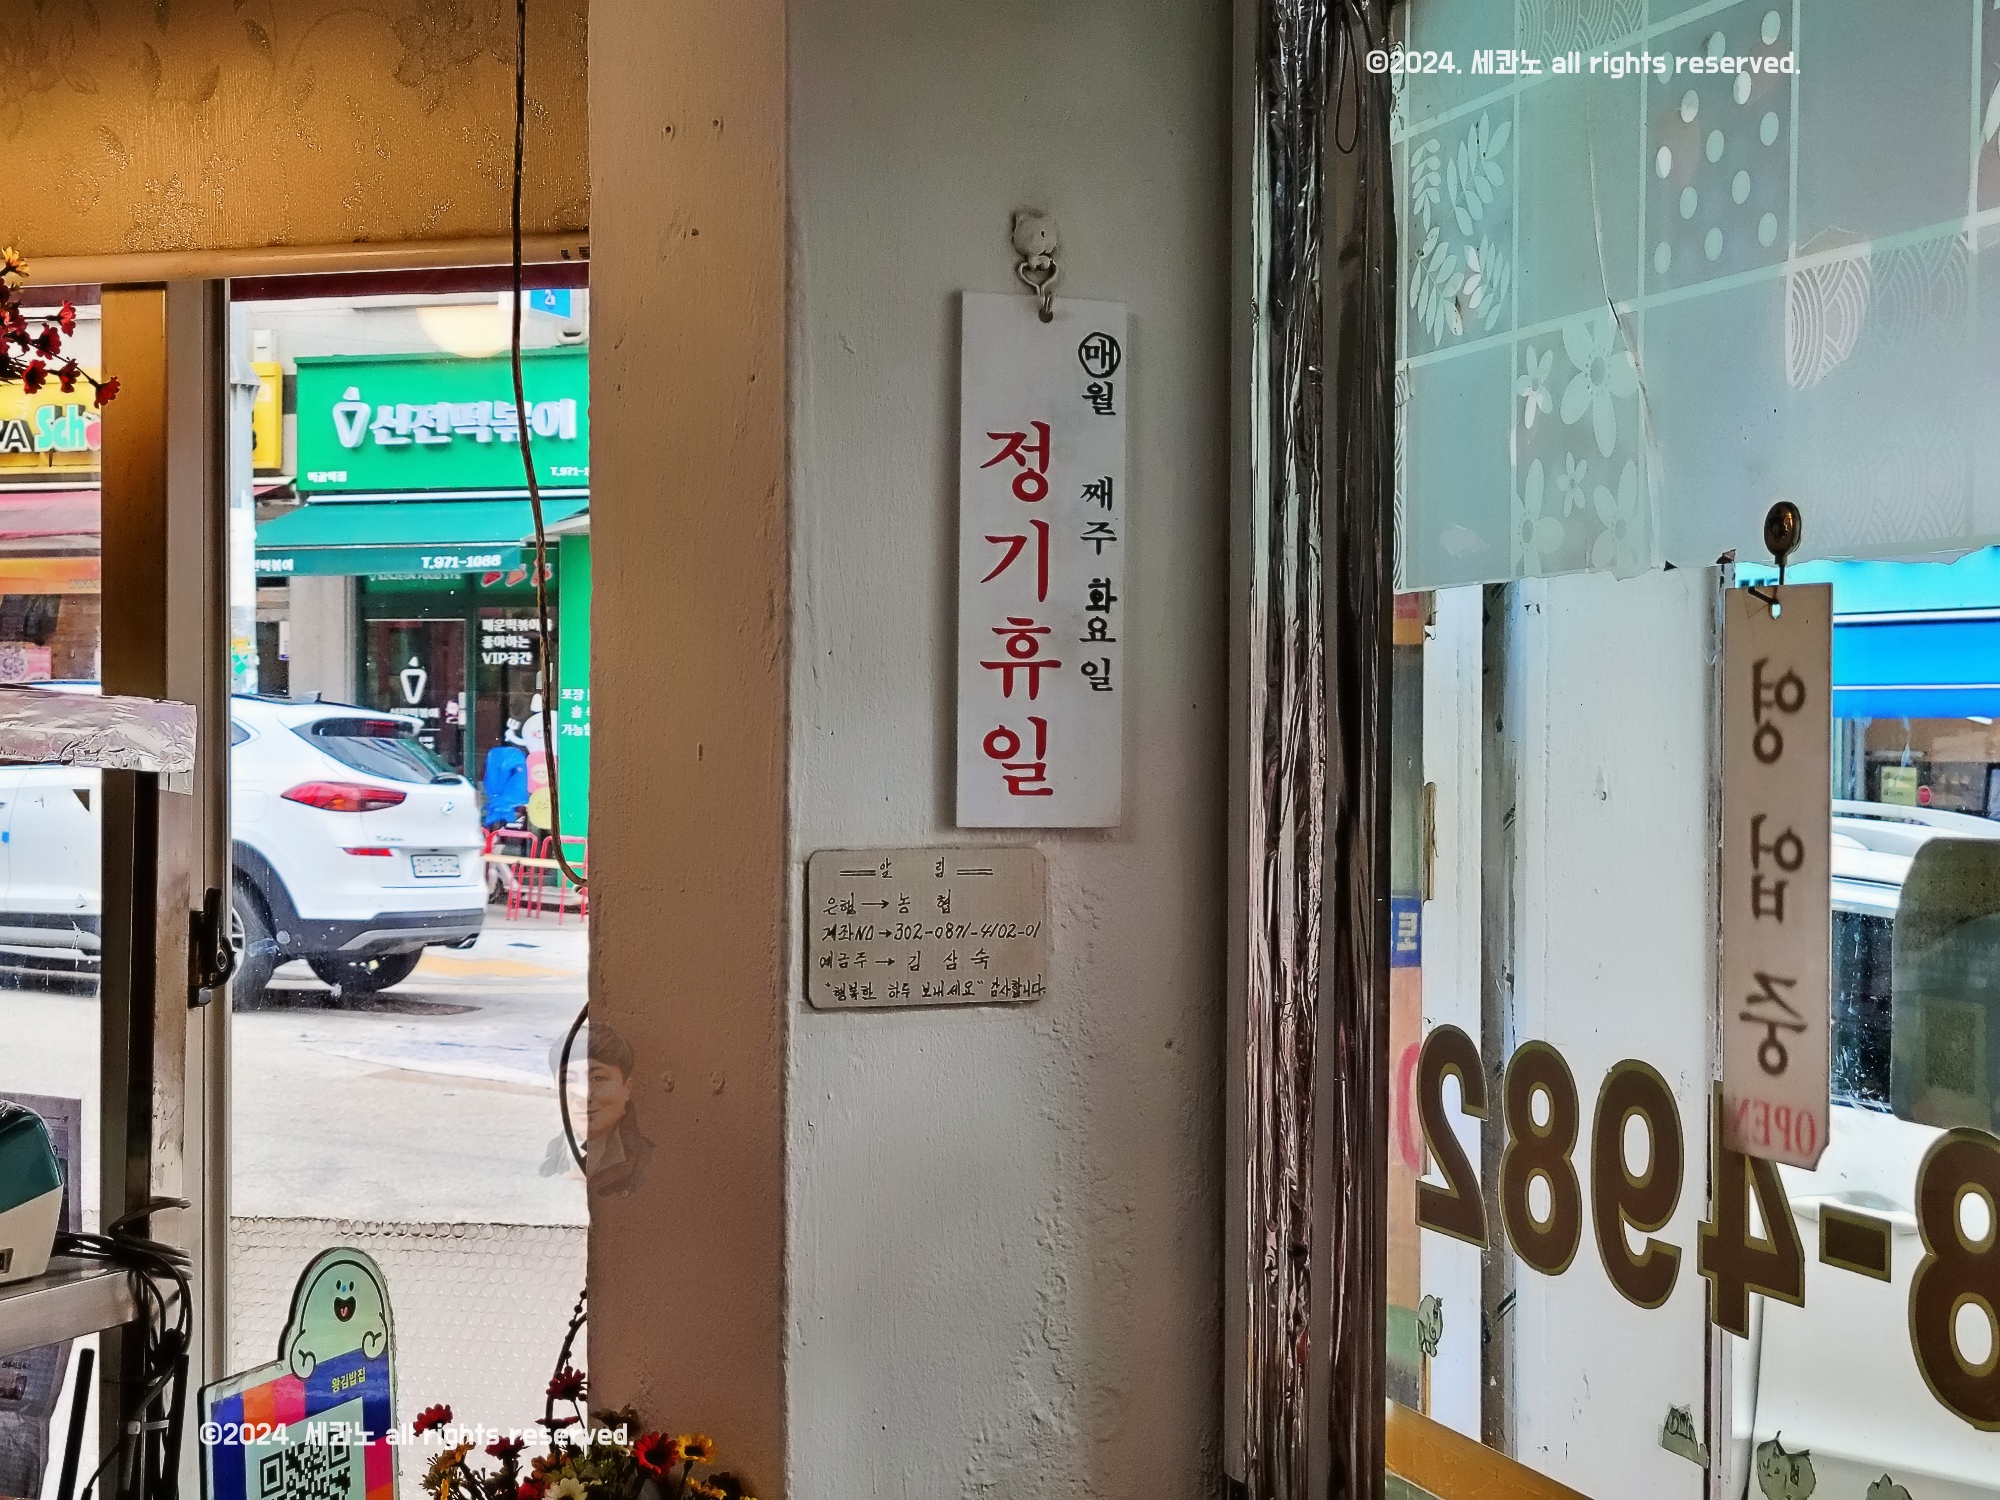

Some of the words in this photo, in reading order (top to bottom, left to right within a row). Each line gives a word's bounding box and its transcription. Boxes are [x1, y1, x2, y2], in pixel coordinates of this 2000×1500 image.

[0, 418, 34, 454] A
[370, 397, 578, 446] 신전떡볶이
[980, 420, 1062, 797] 정기휴일
[331, 1366, 367, 1394] 왕김밥집
